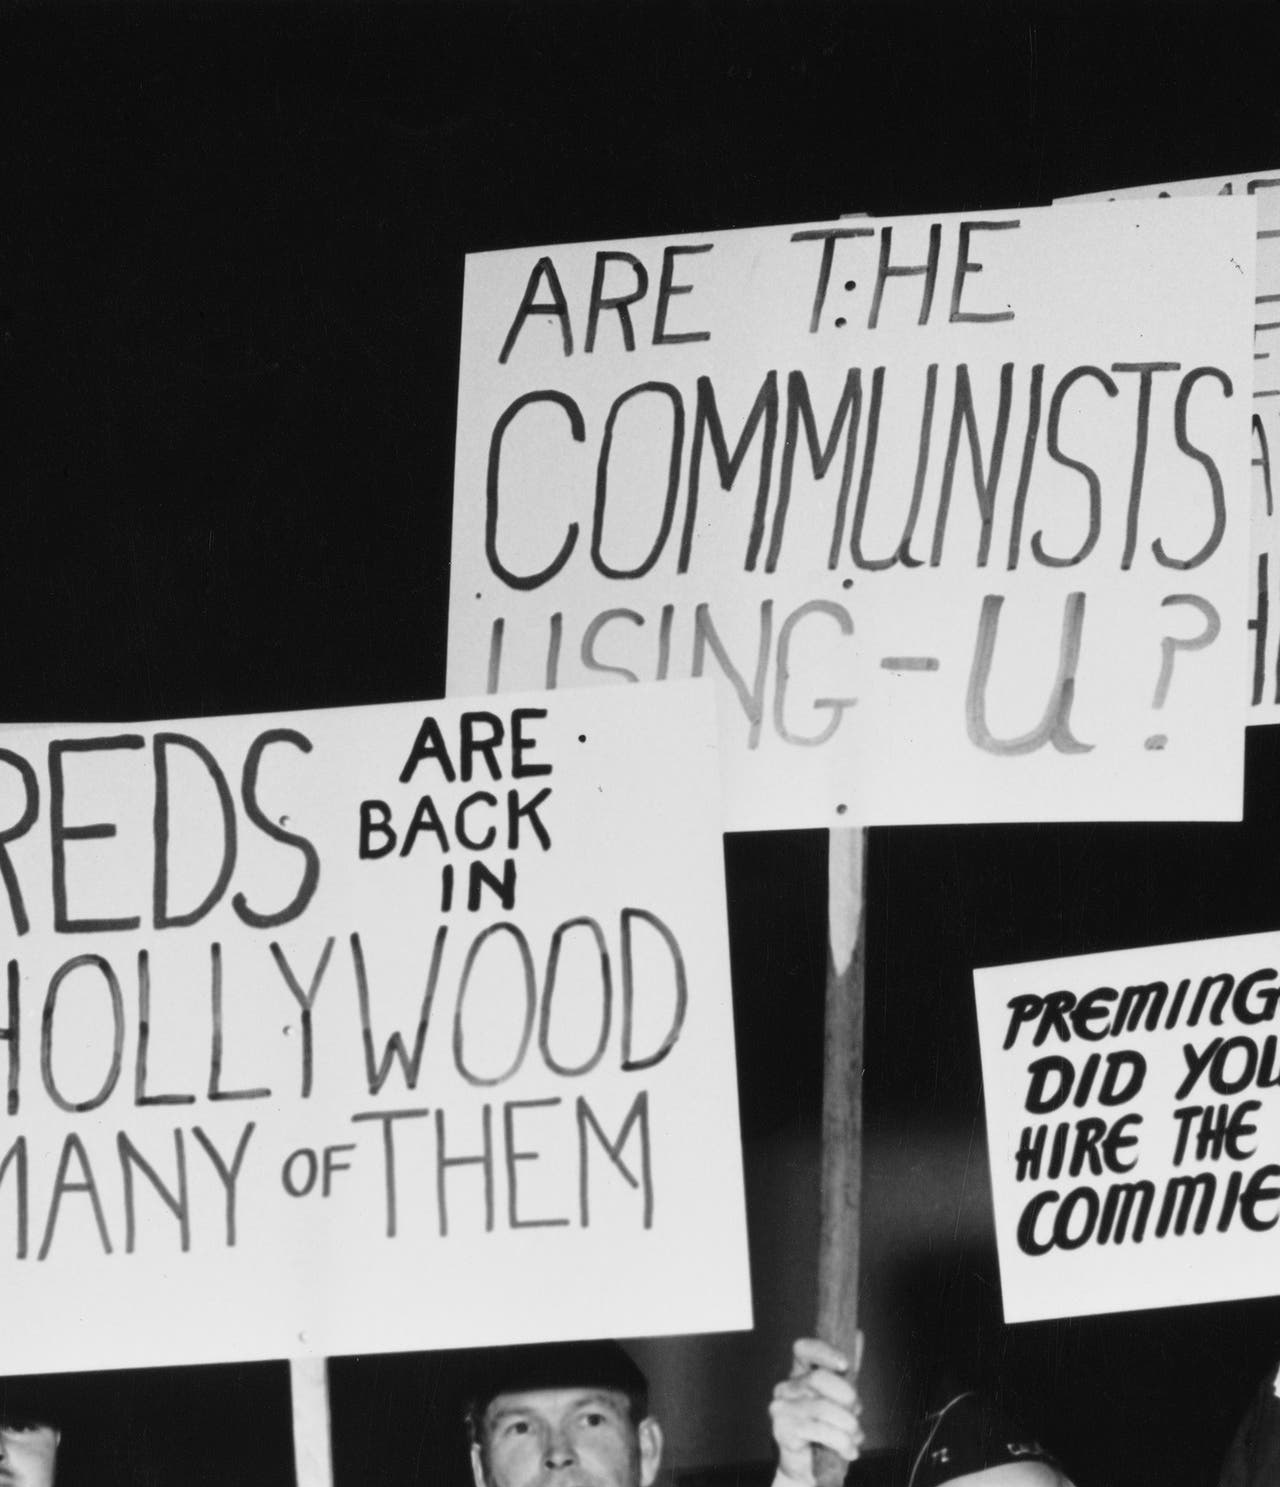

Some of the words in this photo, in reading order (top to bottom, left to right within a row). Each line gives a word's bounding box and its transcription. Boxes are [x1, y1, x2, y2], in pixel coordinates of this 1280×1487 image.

[499, 244, 713, 364] ARE
[790, 220, 1020, 333] THE
[486, 364, 1233, 591] COMMUNISTS
[400, 708, 553, 783] ARE
[359, 788, 553, 859] BACK
[442, 860, 517, 912] IN
[1025, 1049, 1146, 1114] DID
[282, 1143, 357, 1199] OF
[352, 1091, 655, 1238] THEM
[1016, 1112, 1143, 1181] HIRE
[1173, 1101, 1262, 1166] THE
